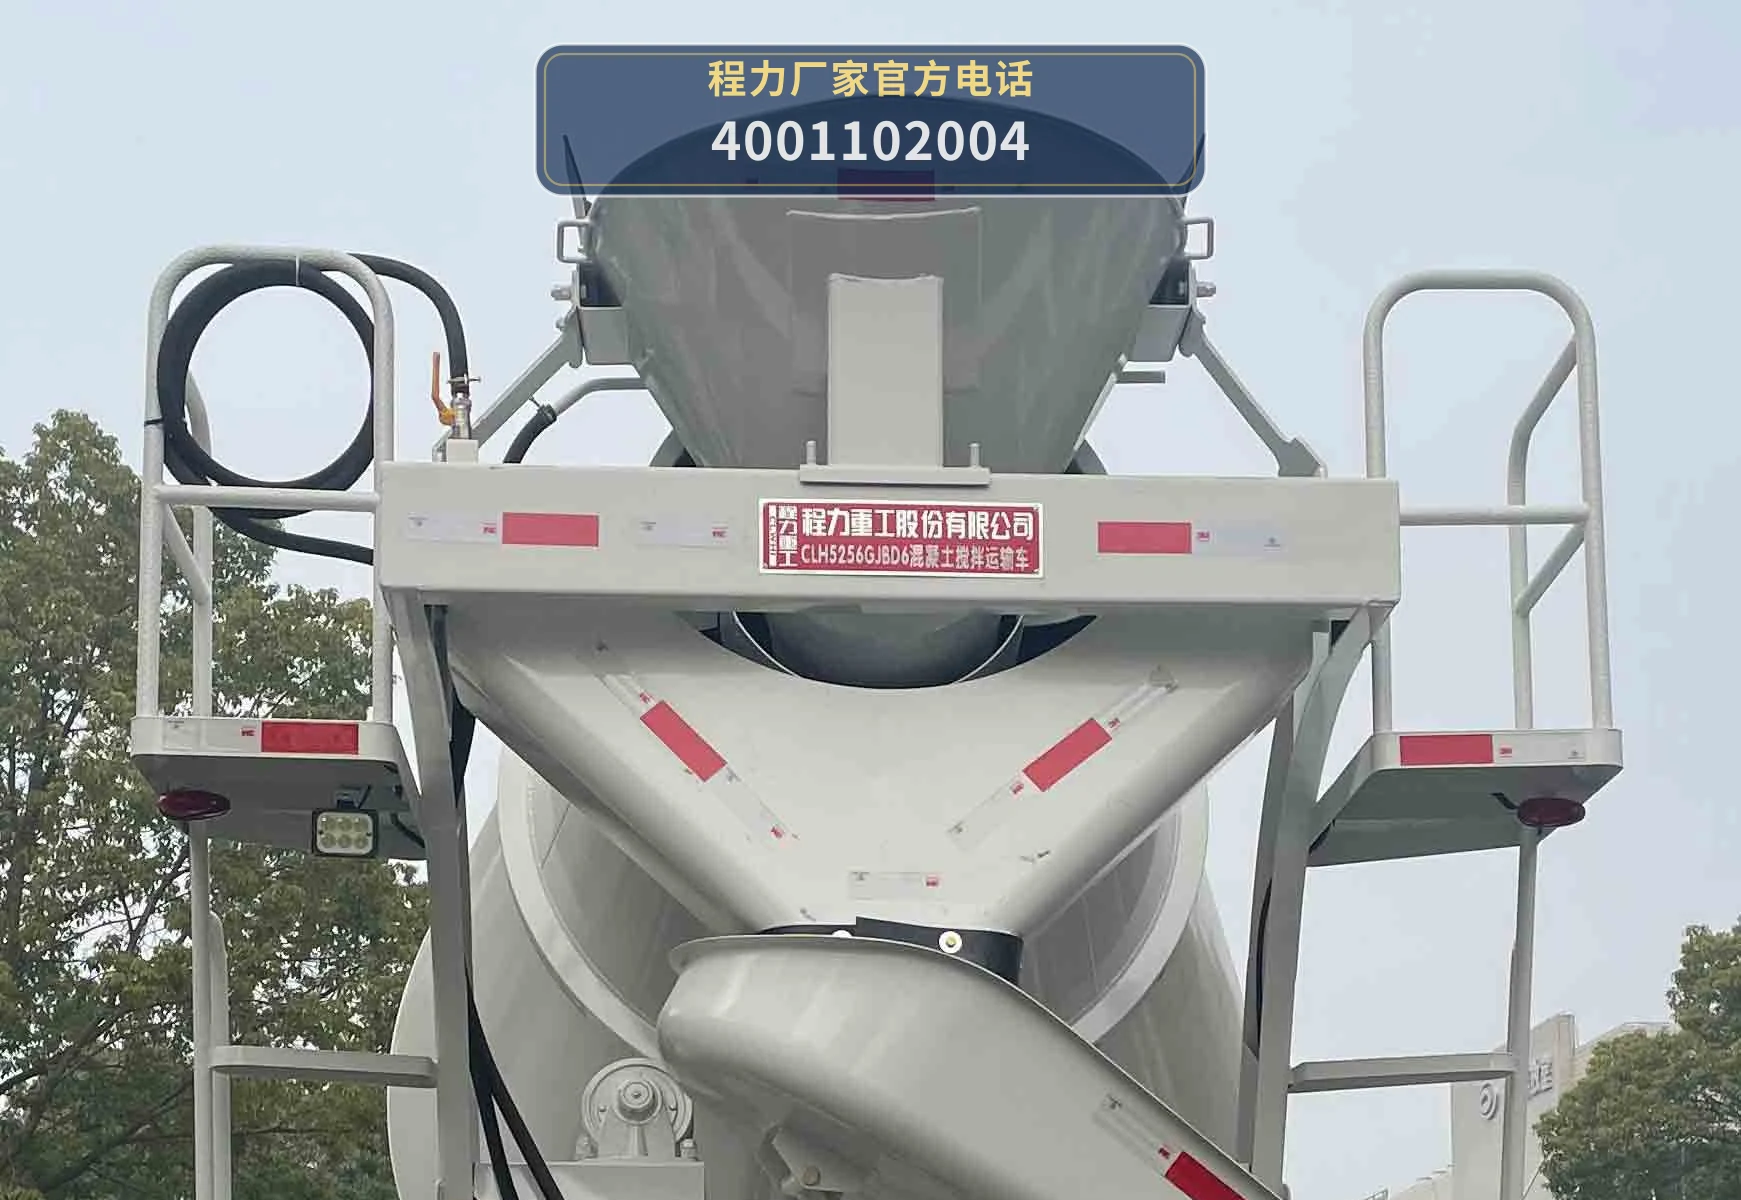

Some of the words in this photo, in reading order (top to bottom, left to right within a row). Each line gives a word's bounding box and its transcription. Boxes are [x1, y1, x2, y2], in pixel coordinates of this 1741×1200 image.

[801, 508, 1034, 541] 程力重工股份有限公司
